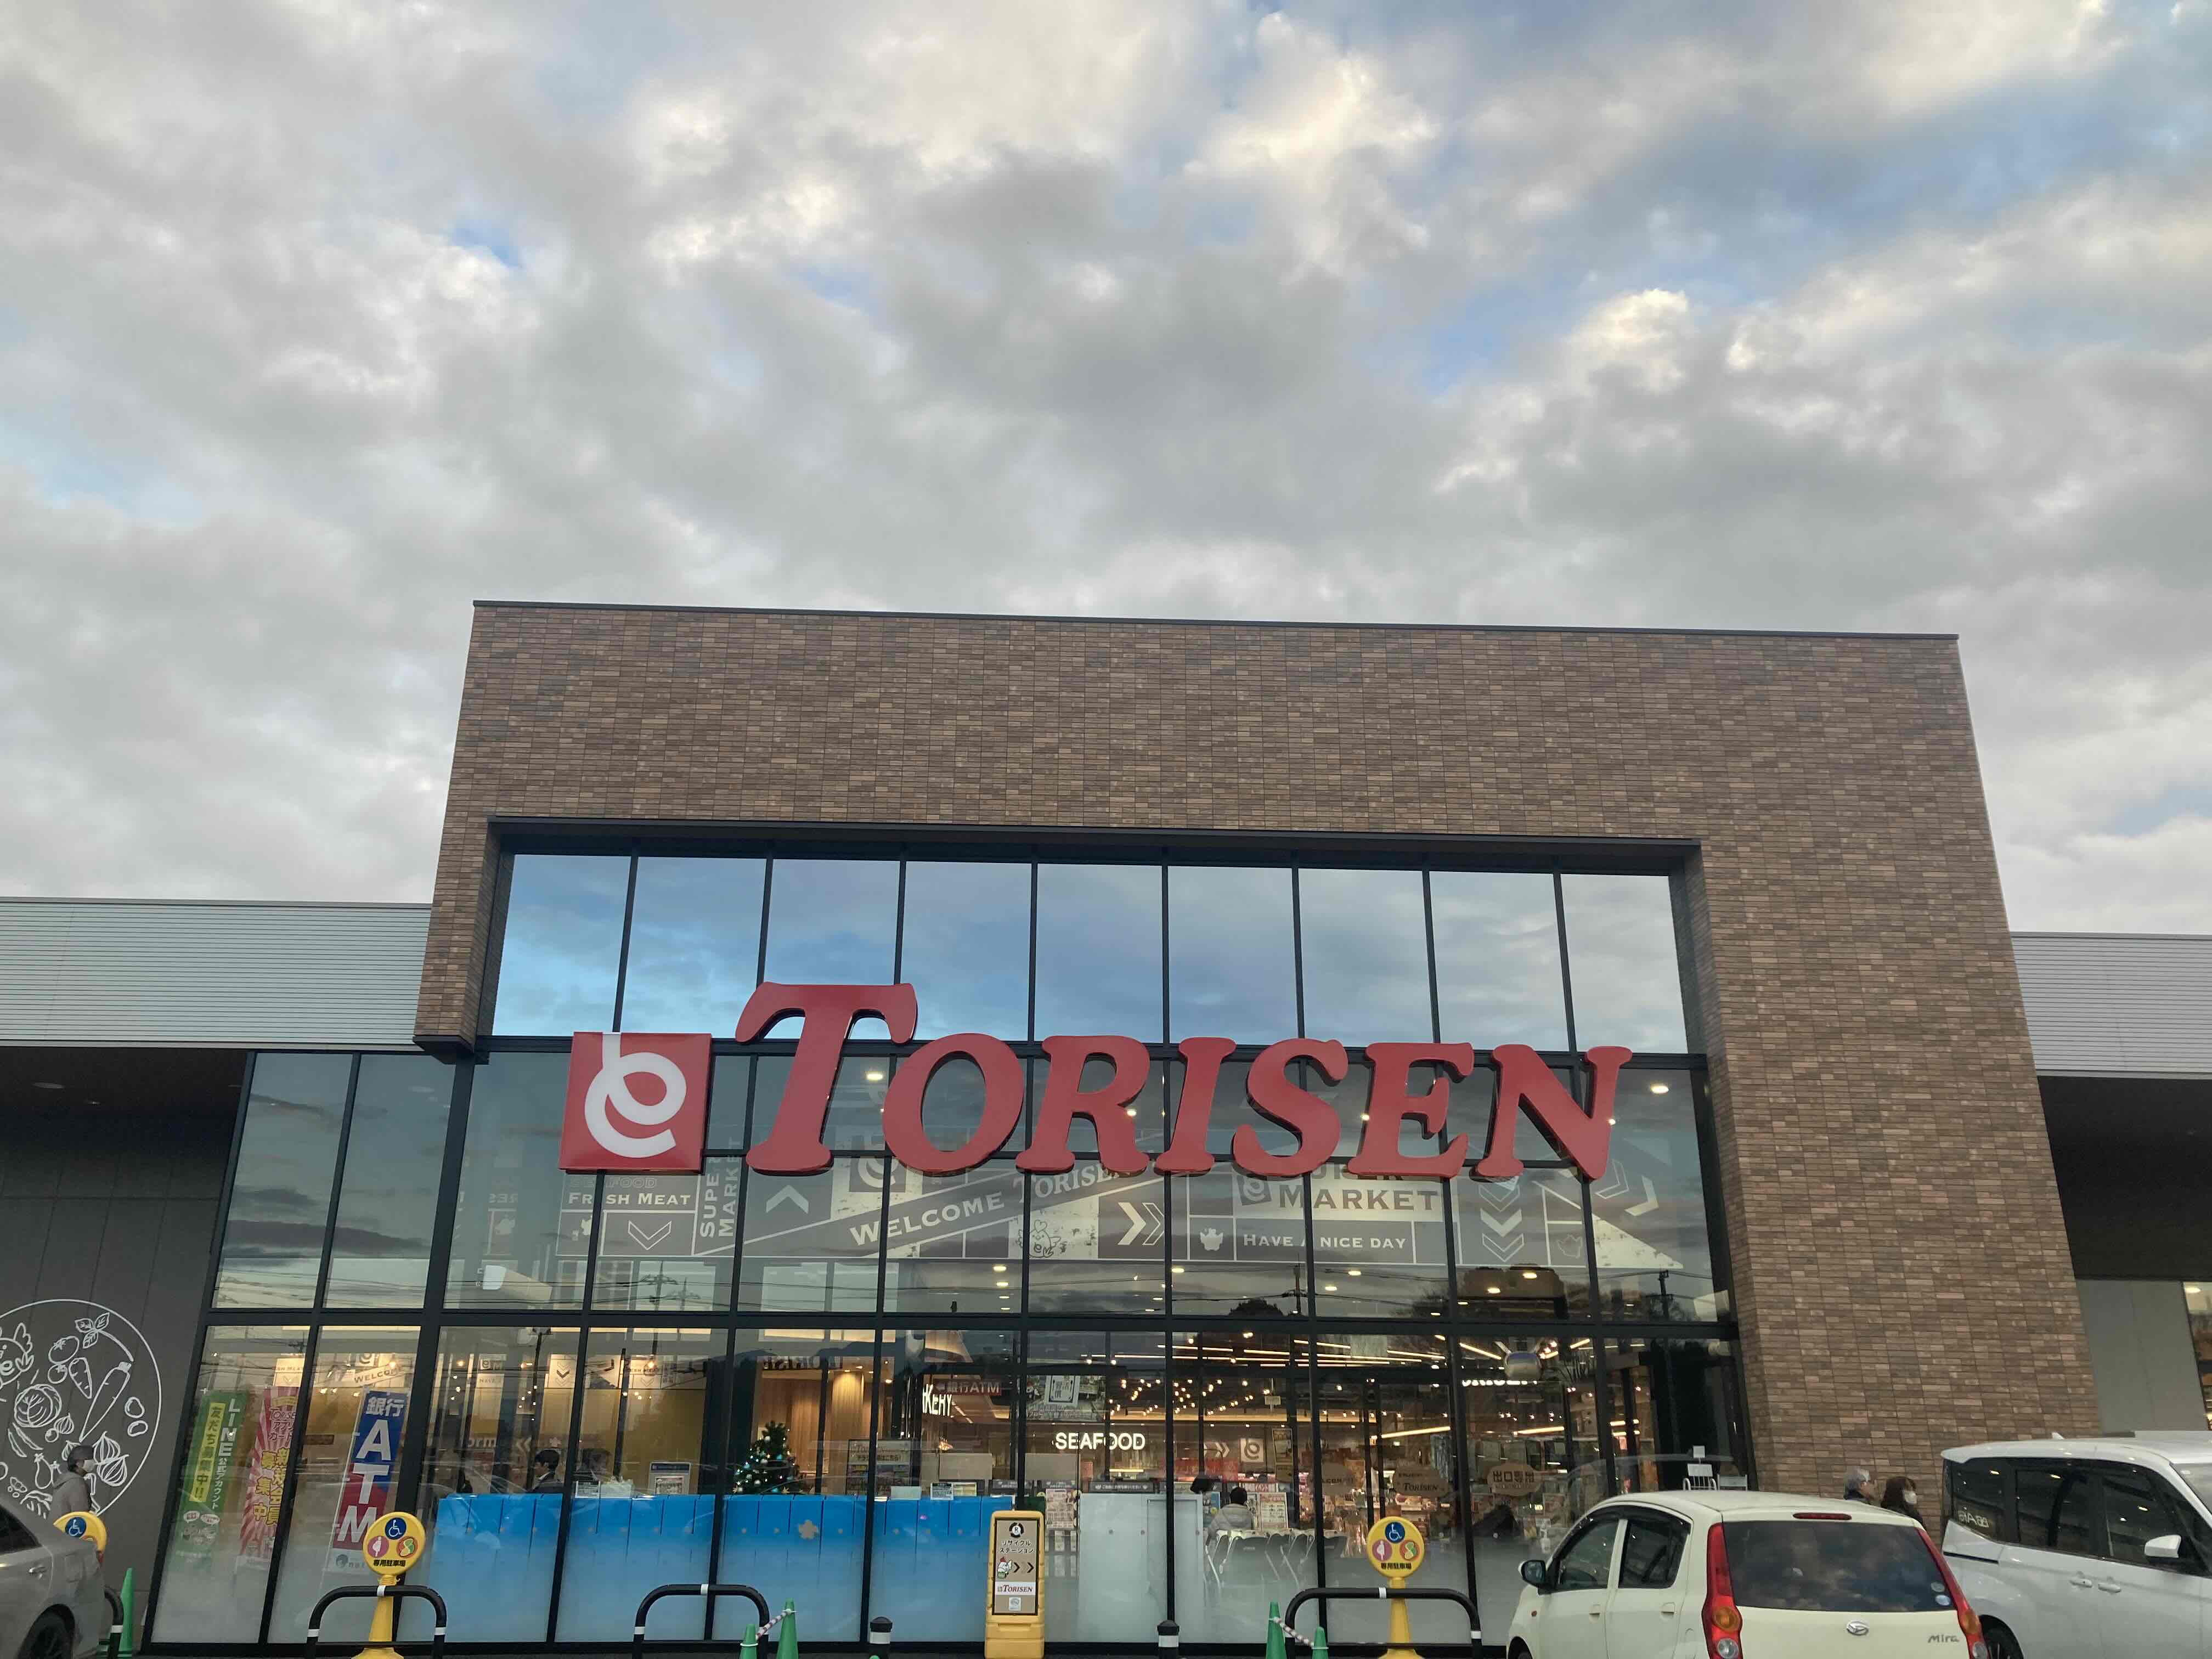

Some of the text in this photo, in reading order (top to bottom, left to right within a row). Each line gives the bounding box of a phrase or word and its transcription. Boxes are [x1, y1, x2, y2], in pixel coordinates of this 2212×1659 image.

[735, 981, 1633, 1183] TORISEN
[568, 1192, 691, 1206] FRSH MEAT
[850, 1163, 1130, 1246] WELCOME TORISE
[1279, 1184, 1438, 1211] MARKET
[1243, 1234, 1294, 1247] HAVE
[1320, 1237, 1364, 1248] NICE
[1369, 1238, 1407, 1250] DAY
[365, 1396, 404, 1417] 銀行
[1054, 1432, 1146, 1450] SEAFOOD
[337, 1419, 391, 1543] ATM
[1003, 1584, 1033, 1593] TORISEN
[1927, 1634, 1959, 1644] Mira
